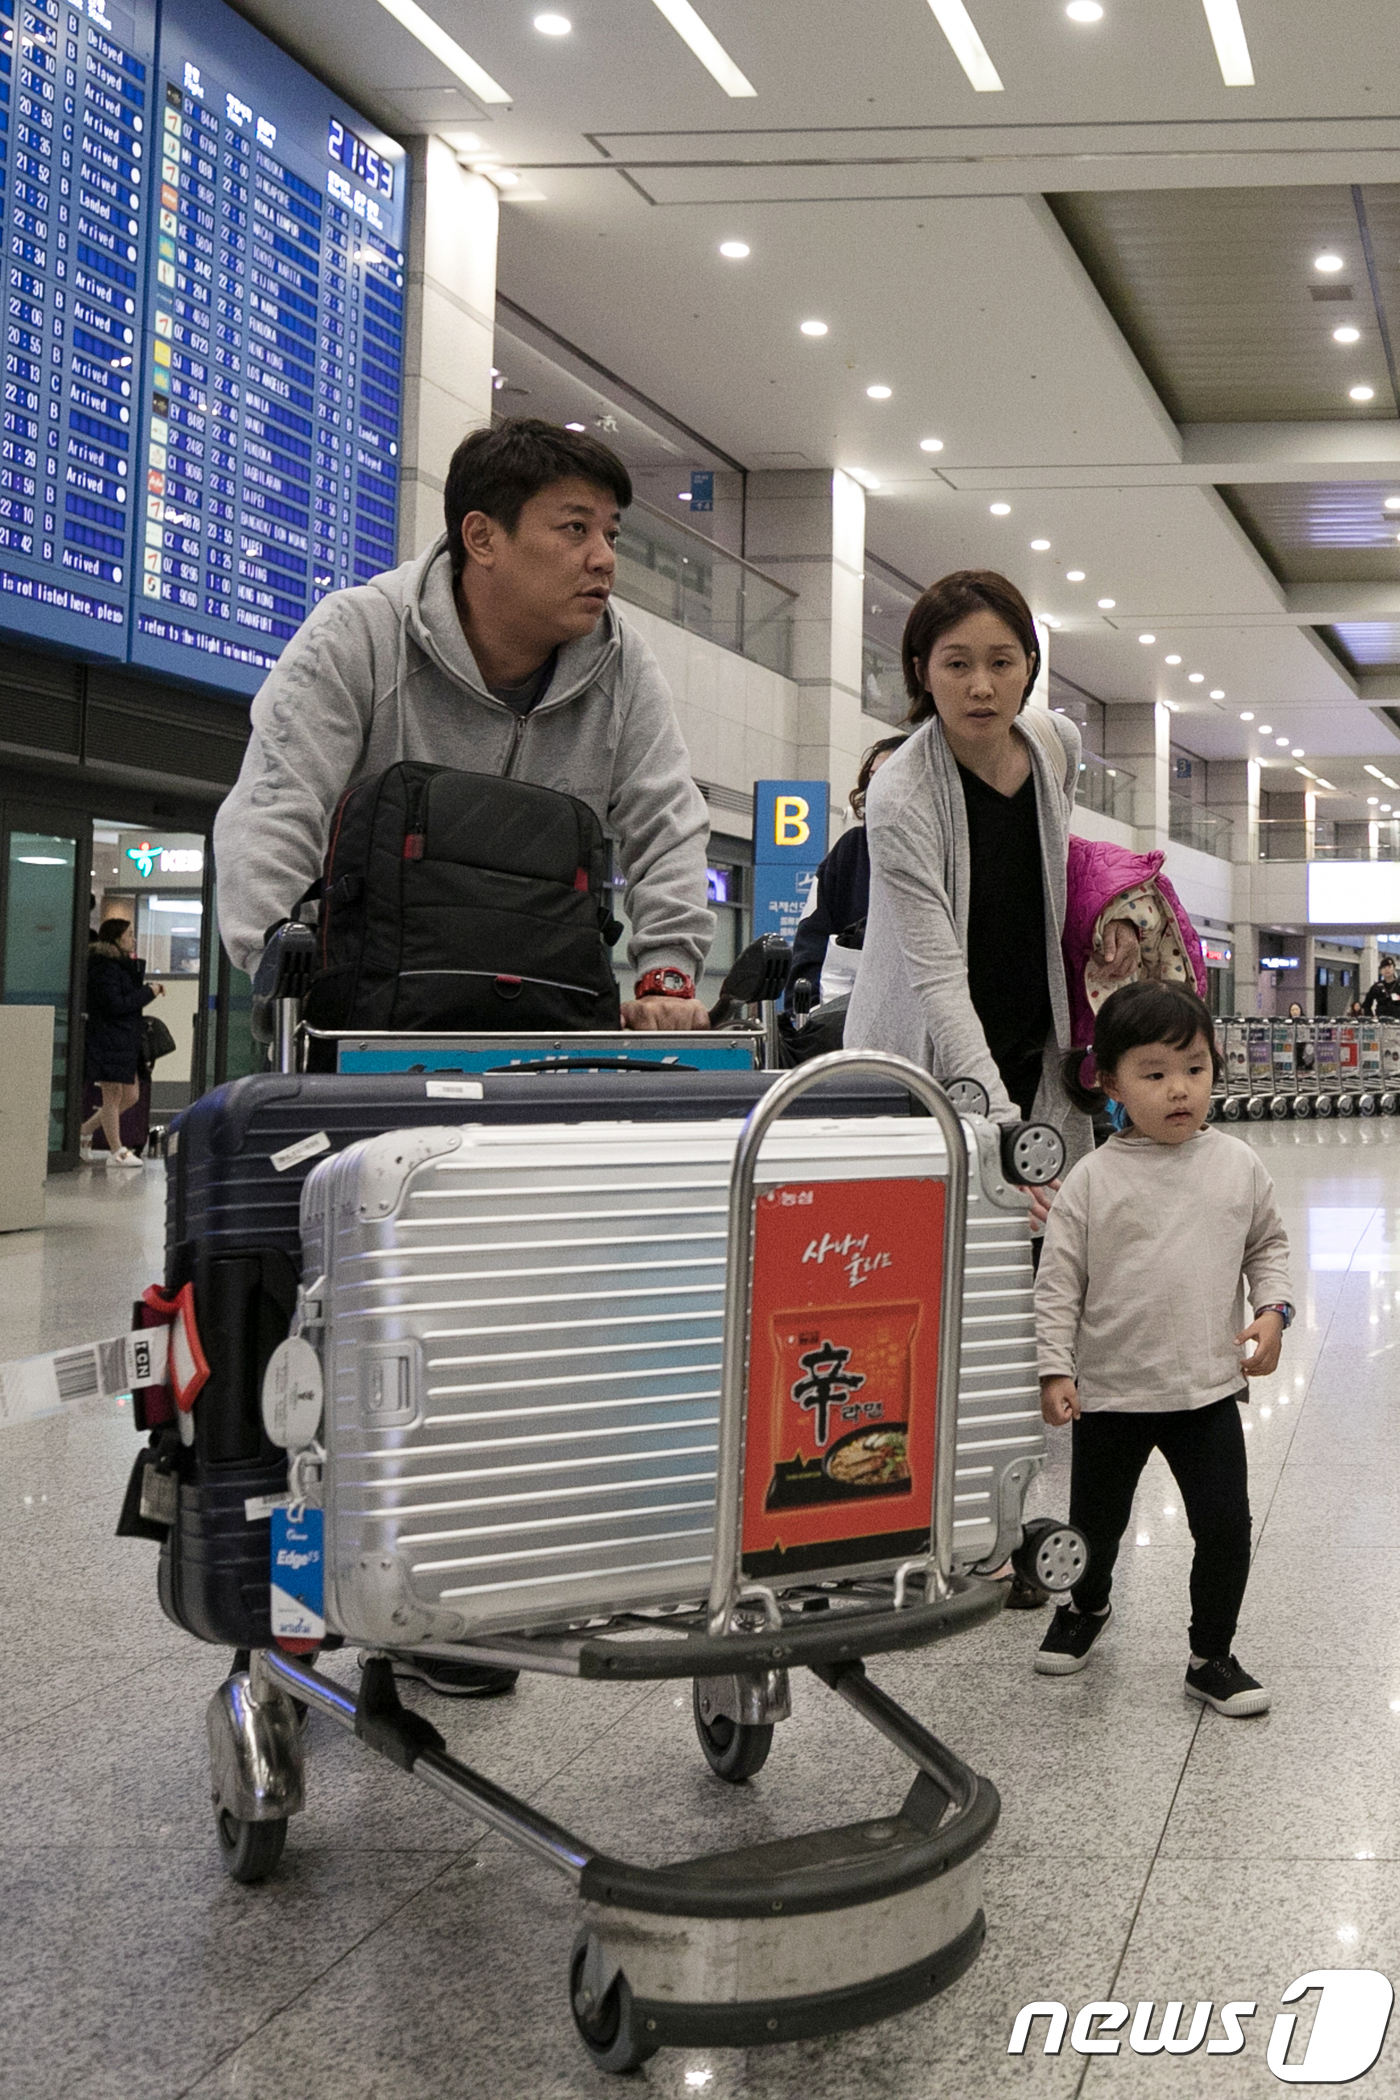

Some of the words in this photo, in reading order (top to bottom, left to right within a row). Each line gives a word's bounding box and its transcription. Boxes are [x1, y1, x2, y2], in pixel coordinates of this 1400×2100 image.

[24, 12, 56, 48] 22:54
[67, 41, 75, 60] B
[85, 55, 121, 93] Delayed
[68, 14, 76, 33] B
[87, 28, 123, 67] Delayed
[20, 67, 53, 102] 21:00
[64, 95, 72, 114] C
[83, 109, 119, 146] Arrived
[21, 39, 54, 75] 21:10
[66, 68, 73, 87] B
[84, 82, 120, 120] Arrived
[19, 95, 52, 130] 20:53
[63, 122, 71, 141] C
[82, 136, 118, 172] Arrived
[183, 123, 192, 141] OZ
[223, 151, 248, 180] 22:00
[184, 98, 193, 116] EY
[224, 127, 249, 156] 22:00
[16, 151, 49, 184] 21:52
[60, 177, 68, 195] B
[79, 189, 110, 221] Landed
[17, 123, 51, 157] 21:35
[62, 150, 70, 169] B
[80, 163, 116, 198] Arrived
[182, 148, 191, 166] MH
[222, 175, 247, 204] 22:15
[328, 119, 394, 199] 21:53
[15, 180, 48, 213] 21:27
[59, 205, 67, 223] B
[78, 217, 114, 251] Arrived
[179, 198, 189, 216] 7C
[196, 208, 213, 231] 1107
[220, 224, 245, 252] 22:20
[181, 173, 190, 191] OZ
[221, 200, 246, 228] 22:15
[13, 207, 47, 239] 22:00
[58, 231, 66, 250] B
[12, 237, 45, 268] 21:34
[57, 260, 65, 278] B
[75, 271, 111, 304] Arrived
[177, 248, 186, 266] VN
[193, 258, 211, 280] 3442
[218, 272, 243, 299] 22:20
[250, 291, 258, 308] DA
[260, 297, 277, 319] NANG
[178, 223, 187, 241] KE
[219, 248, 244, 275] 22:20
[251, 268, 278, 296] BEIJING
[9, 298, 43, 328] 22:06
[54, 319, 62, 337] B
[11, 269, 44, 300] 21:31
[55, 291, 63, 309] B
[74, 302, 110, 334] Arrived
[217, 297, 242, 323] 22:25
[249, 315, 276, 343] FUKUOKA
[8, 326, 41, 356] 20:55
[53, 346, 61, 364] B
[71, 357, 108, 387] Arrived
[174, 324, 183, 341] OZ
[190, 333, 208, 354] 6723
[215, 346, 240, 371] 22:35
[247, 363, 260, 382] LOS
[262, 371, 289, 397] ANGELES
[216, 322, 241, 348] 22:30
[5, 383, 39, 411] 22:01
[50, 402, 58, 419] B
[7, 355, 40, 384] 21:13
[51, 374, 59, 392] C
[70, 384, 106, 414] Arrived
[172, 353, 182, 370] 5J
[189, 361, 203, 381] 188
[214, 374, 239, 399] 22:40
[4, 412, 37, 440] 21:18
[49, 430, 57, 447] C
[68, 439, 104, 467] Arrived
[169, 429, 178, 446] 2P
[210, 448, 236, 472] 22:45
[170, 403, 179, 420] EY
[211, 423, 237, 447] 22:40
[1, 470, 35, 496] 21:58
[46, 486, 54, 503] B
[2, 441, 36, 468] 21:29
[47, 458, 55, 475] B
[66, 467, 103, 495] Arrived
[168, 454, 177, 471] CI
[209, 473, 235, 496] 22:55
[242, 487, 264, 509] TAIPEI
[0, 499, 33, 524] 22:10
[45, 514, 53, 531] B
[167, 480, 176, 497] XJ
[183, 487, 198, 506] 702
[208, 498, 234, 520] 23:05
[0, 528, 32, 553] 21:42
[43, 542, 51, 559] B
[62, 550, 99, 576] Arrived
[164, 531, 174, 548] CZ
[210, 549, 232, 569] 0:25
[238, 560, 267, 582] BEIJING
[207, 522, 233, 545] 23:55
[37, 583, 67, 608] listed
[69, 592, 93, 617] here,
[162, 582, 171, 598] KE
[208, 598, 230, 618] 2:05
[163, 557, 172, 573] OZ
[209, 573, 231, 594] 1:00
[775, 795, 810, 846] B
[780, 1190, 814, 1206] 농심
[801, 1232, 870, 1264] 사나이
[135, 1341, 149, 1378] ICN
[792, 1339, 866, 1446] 辛
[840, 1402, 884, 1424] 라면
